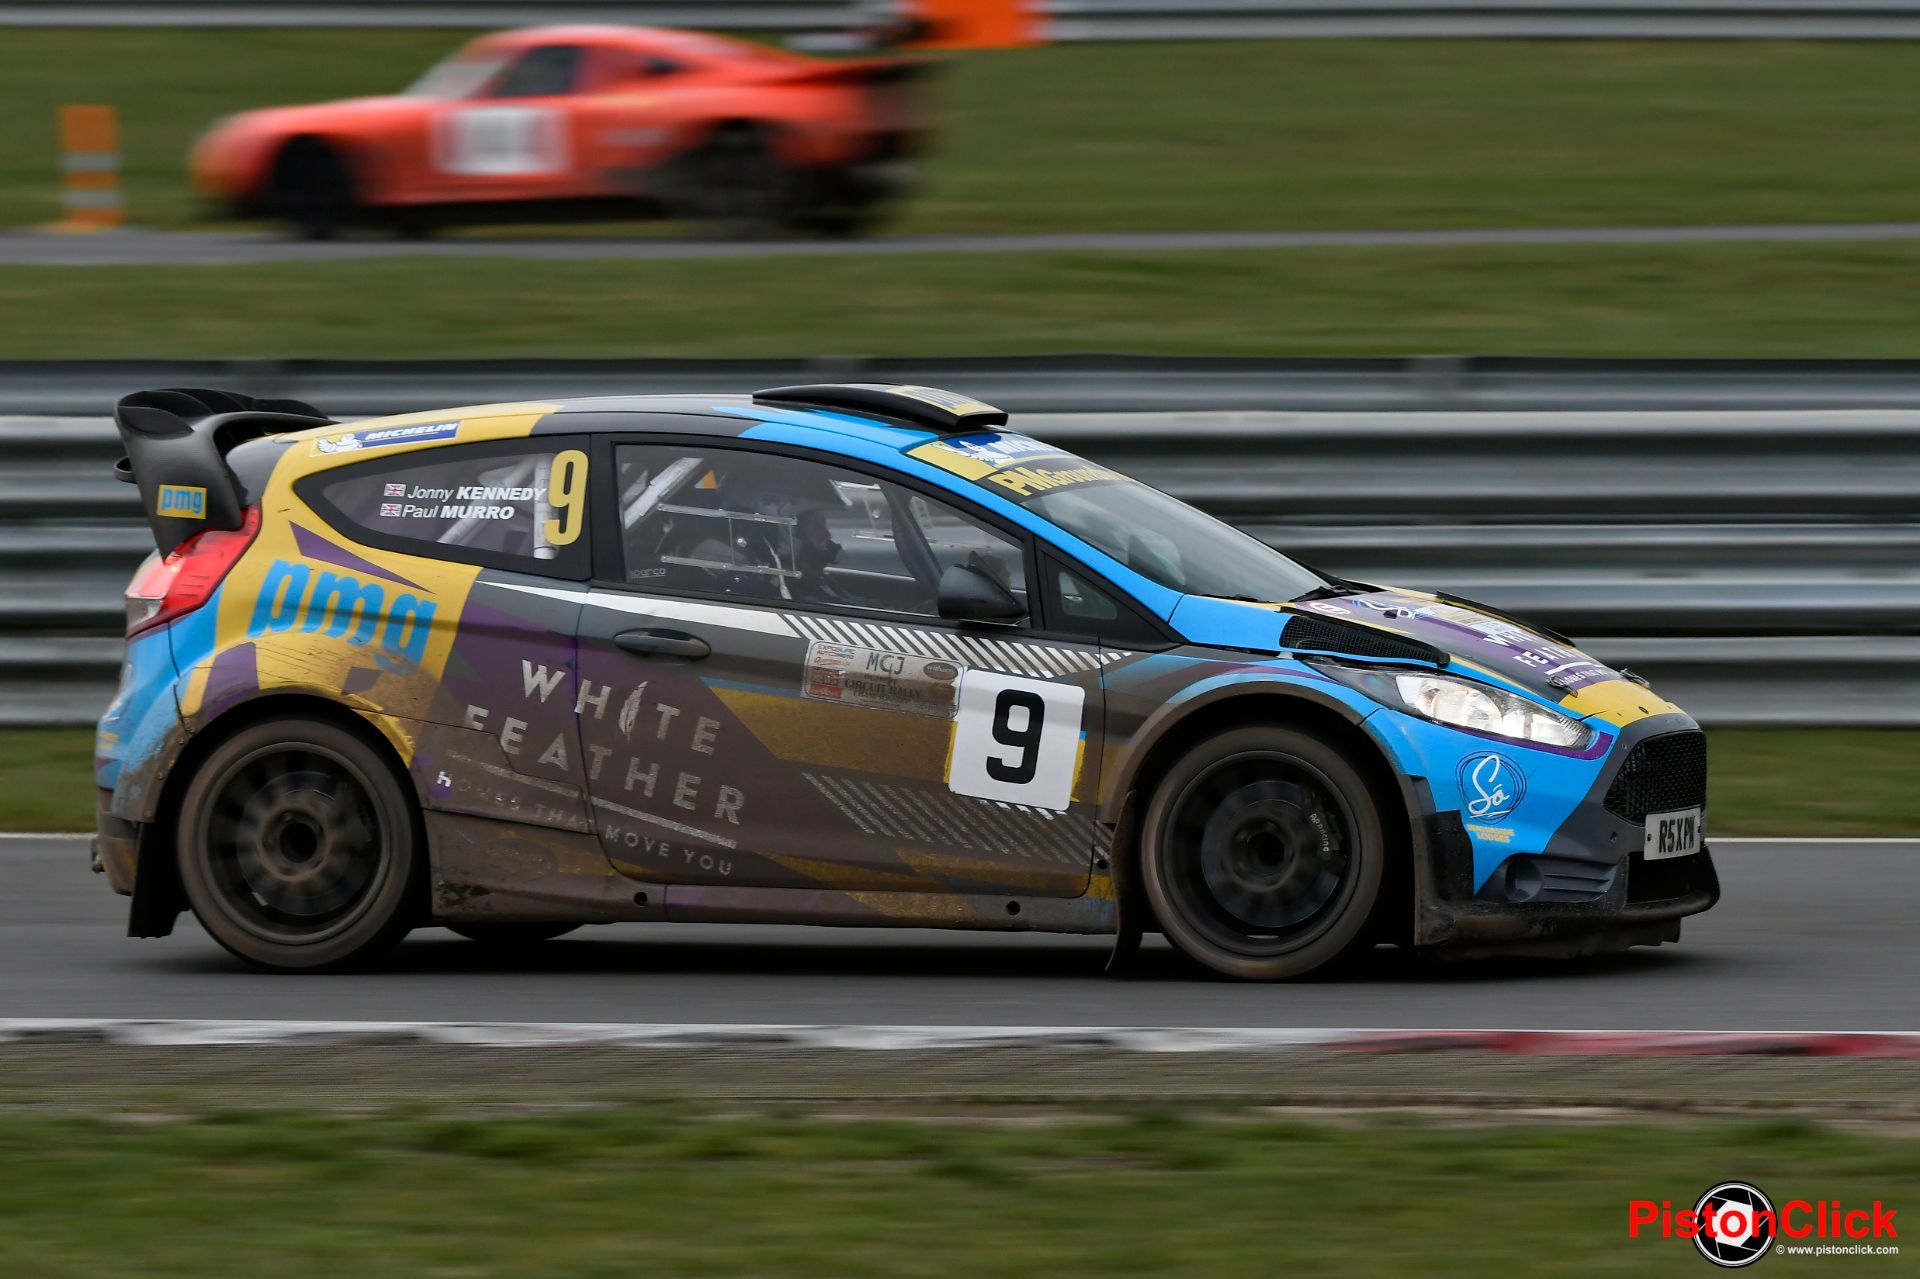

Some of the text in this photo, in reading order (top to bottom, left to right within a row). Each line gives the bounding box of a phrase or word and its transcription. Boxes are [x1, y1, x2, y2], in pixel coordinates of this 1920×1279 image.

[365, 422, 458, 441] MICHELIN
[161, 488, 203, 515] pmg
[402, 504, 515, 520] Paul MURRO
[407, 485, 547, 502] Jonny KENNEDY
[544, 449, 589, 545] 9
[246, 559, 438, 677] pmg
[985, 688, 1045, 785] 9
[465, 704, 746, 825] FEATHER
[605, 824, 670, 857] MOVE
[684, 849, 732, 876] YOU
